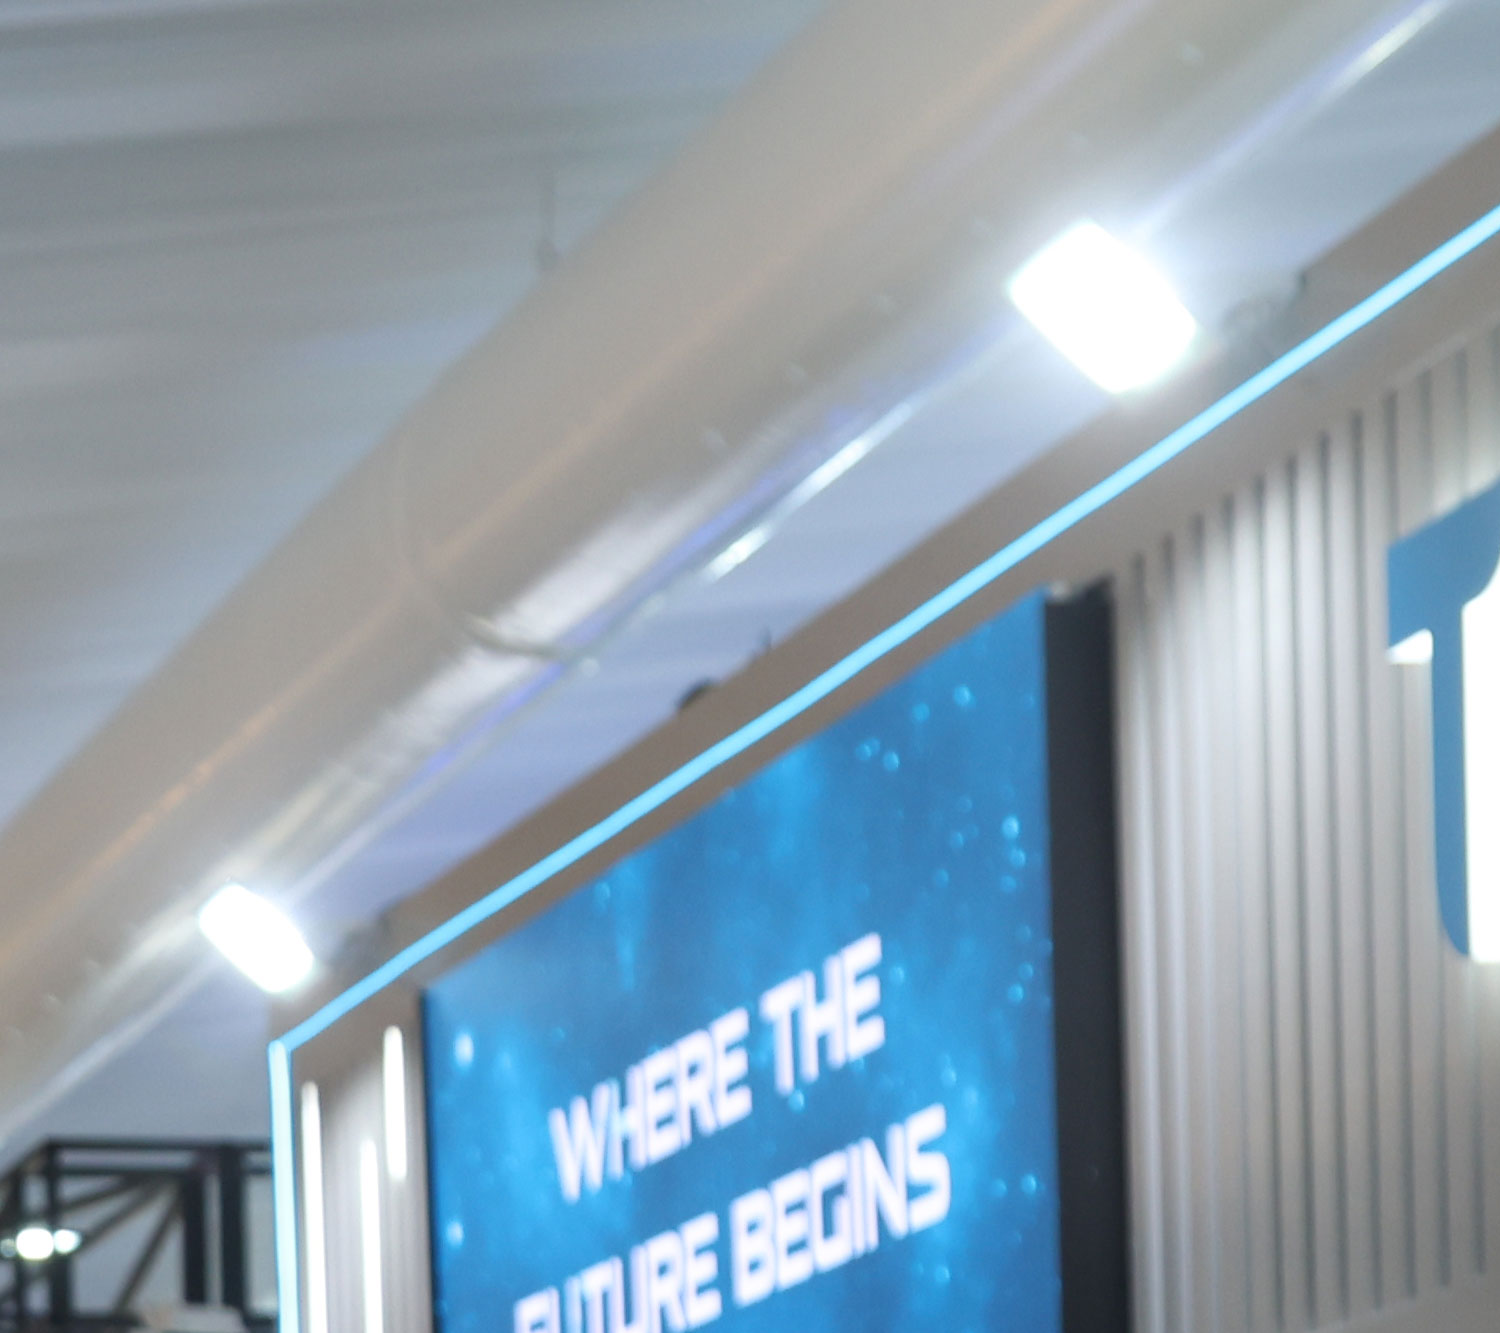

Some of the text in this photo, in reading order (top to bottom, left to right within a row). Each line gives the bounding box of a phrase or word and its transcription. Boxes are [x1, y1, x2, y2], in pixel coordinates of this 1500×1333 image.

[549, 933, 886, 1202] WHERE THE
[731, 1104, 952, 1308] BEGINS
